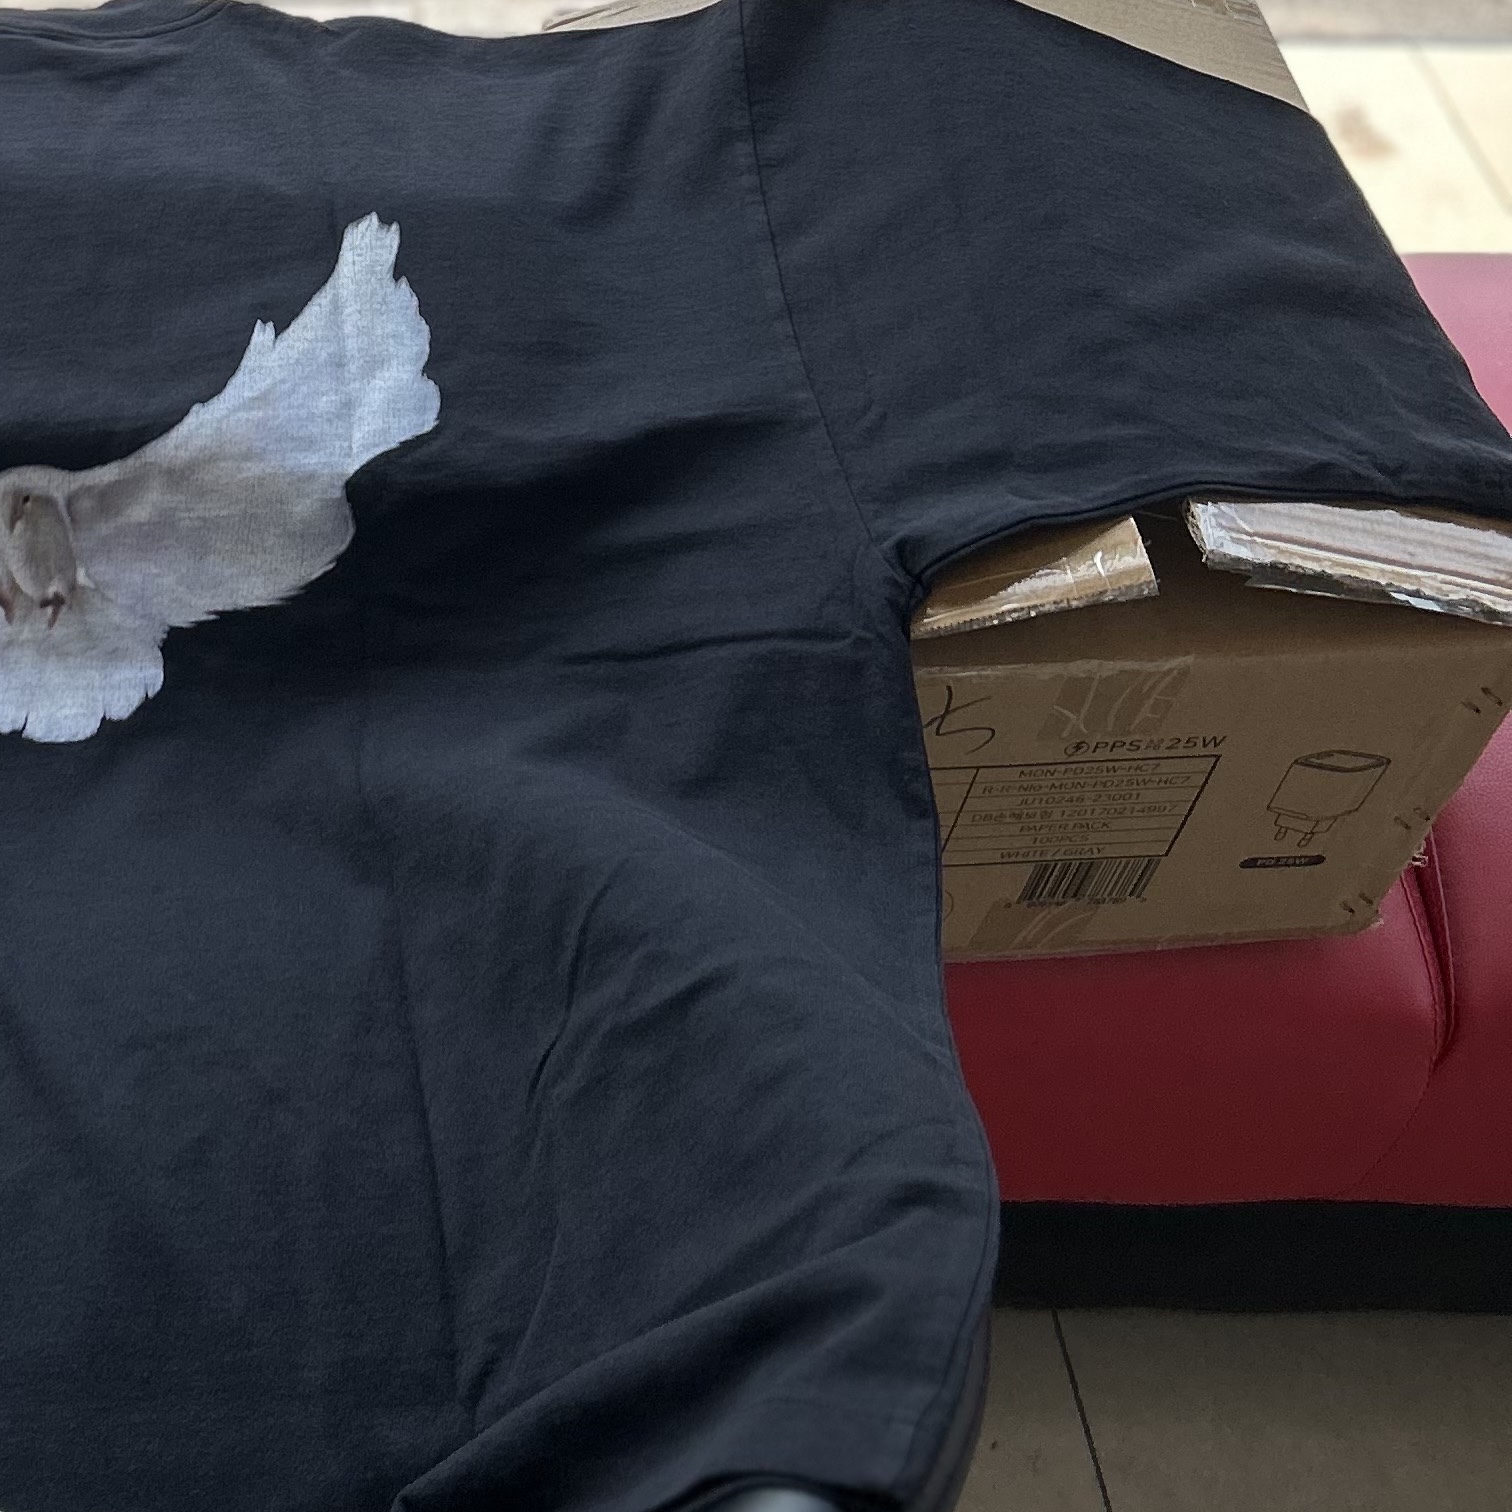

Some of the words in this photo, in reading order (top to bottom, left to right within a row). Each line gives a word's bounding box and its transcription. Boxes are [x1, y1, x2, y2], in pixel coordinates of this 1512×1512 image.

[1019, 823, 1071, 834] PAPER
[1072, 821, 1112, 832] PACK
[999, 849, 1050, 860] WHITE
[1063, 847, 1107, 858] GRAY
